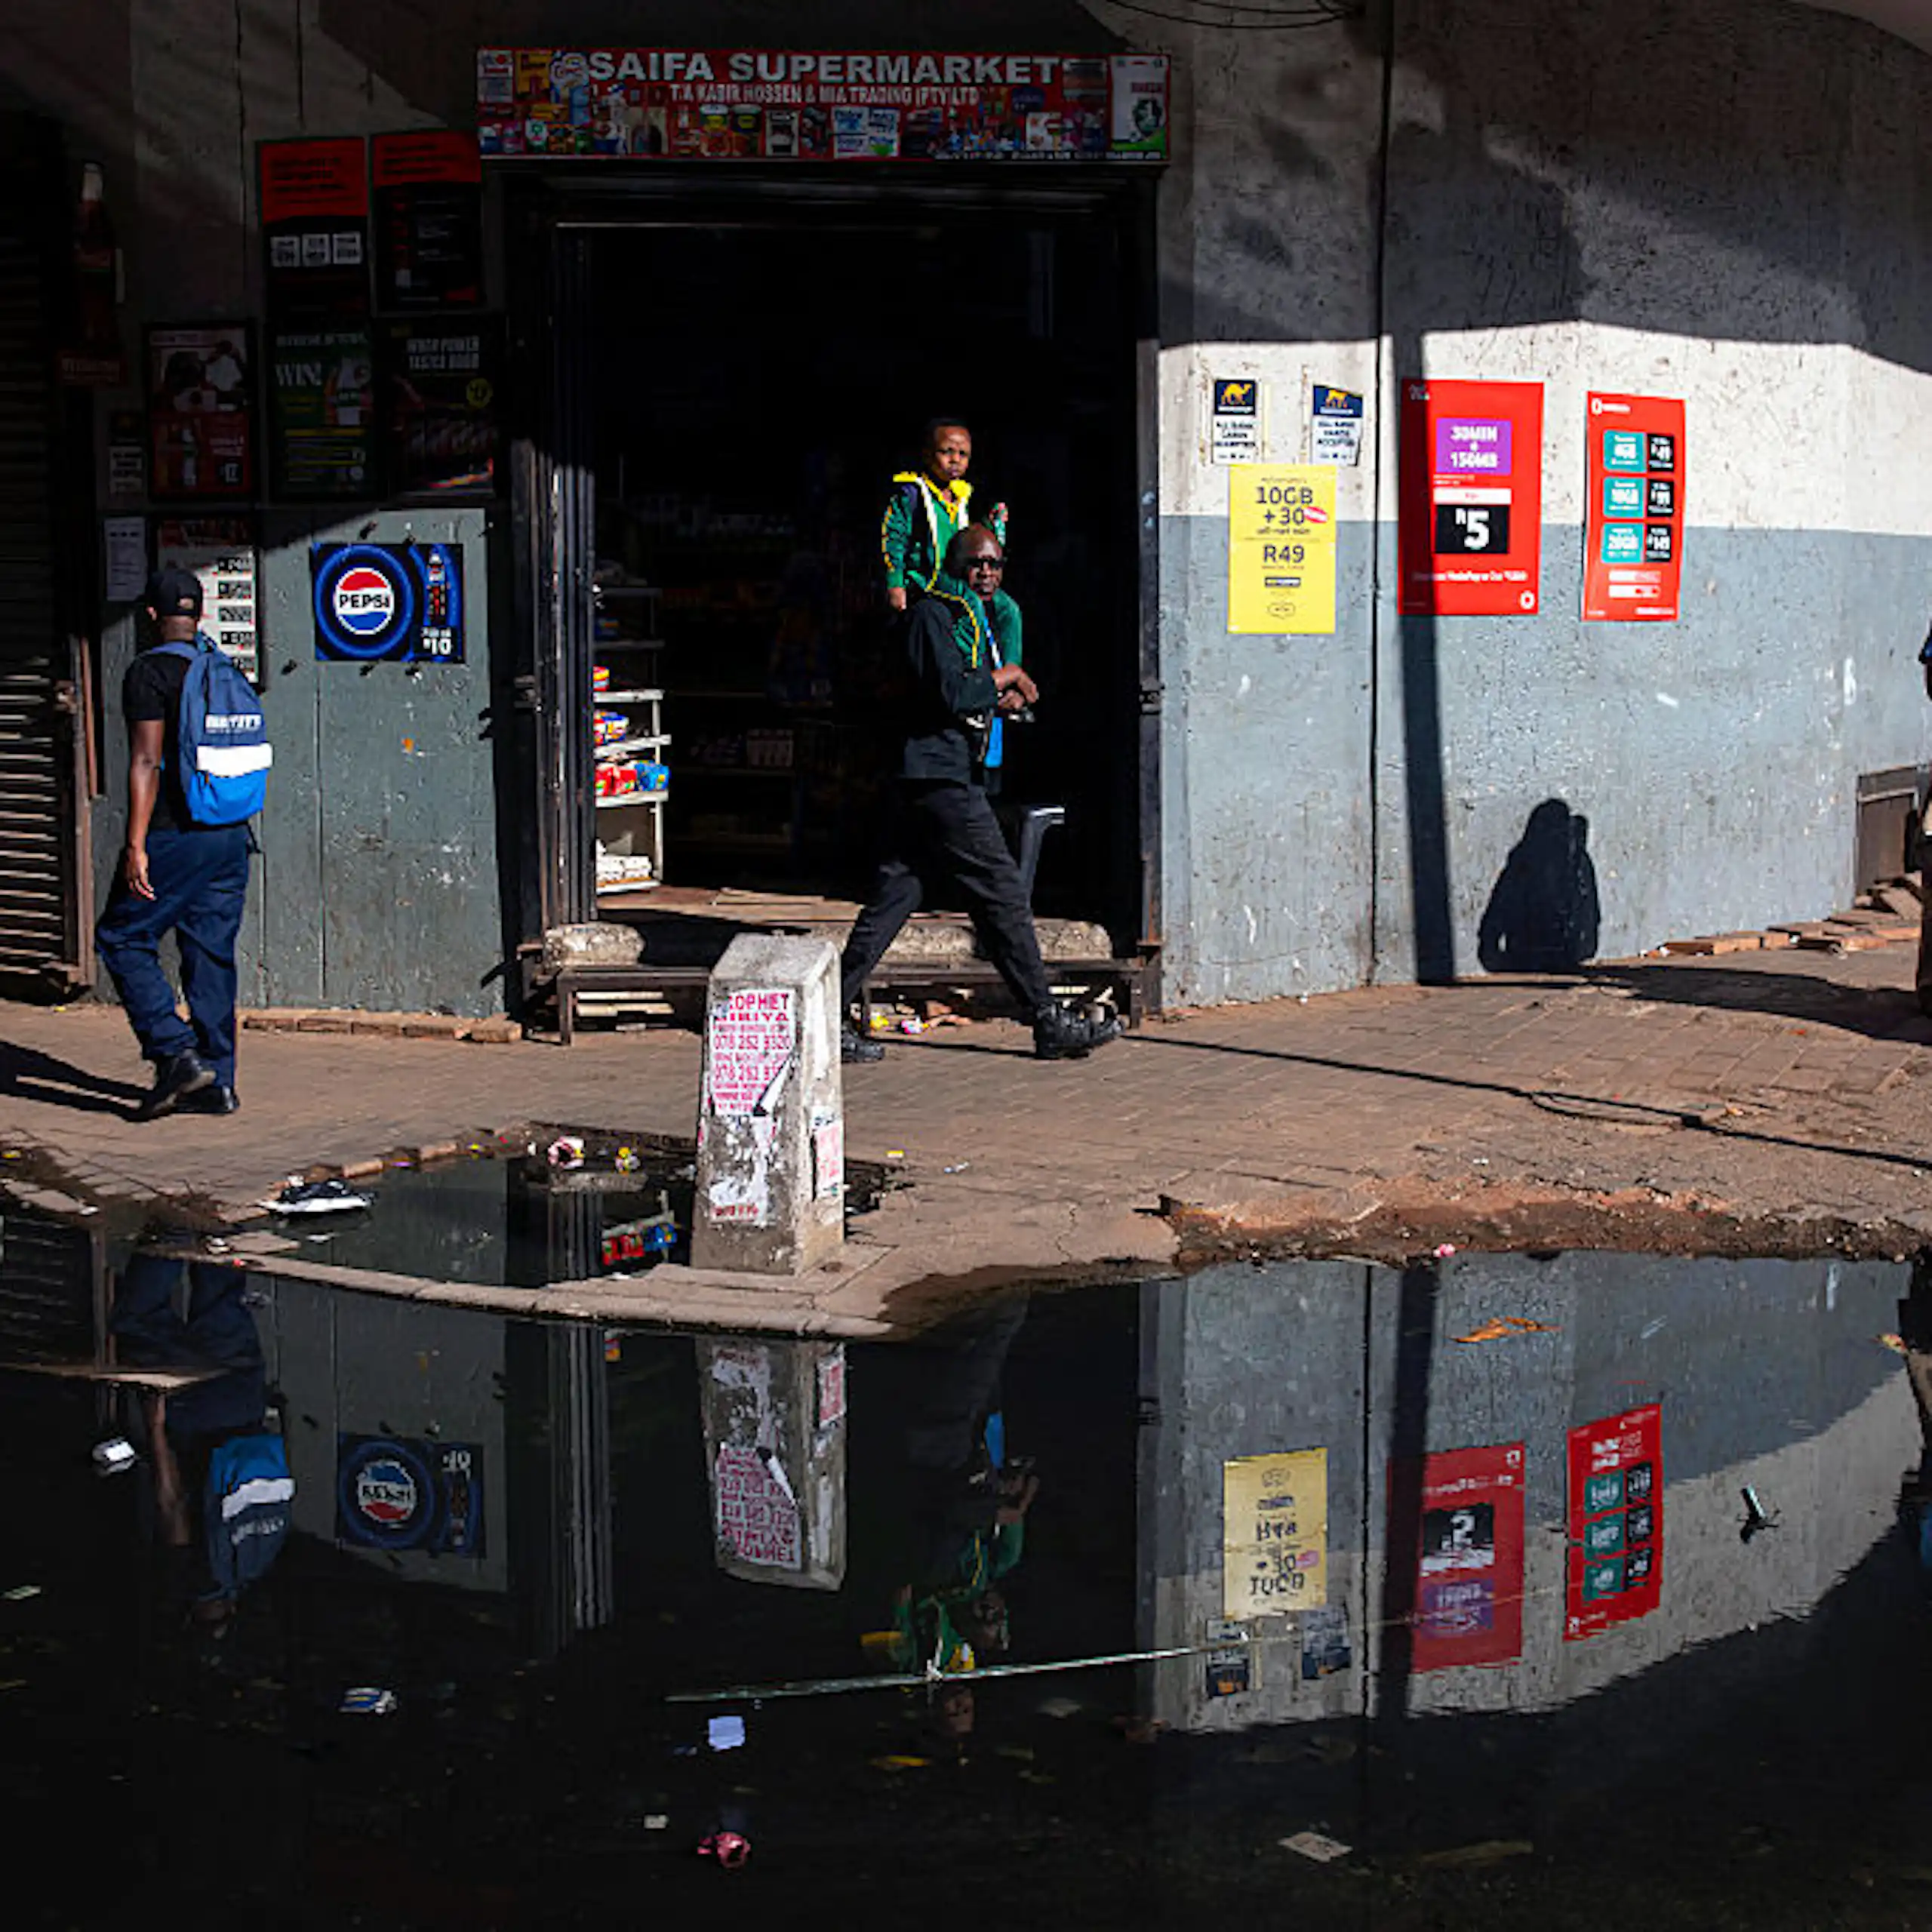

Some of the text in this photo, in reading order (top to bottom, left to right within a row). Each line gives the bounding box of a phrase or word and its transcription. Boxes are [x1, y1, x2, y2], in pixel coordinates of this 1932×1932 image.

[589, 52, 1060, 84] SAIFA SUPERMARKET
[848, 85, 912, 106] TRADING
[1254, 485, 1314, 505] 10GB
[1263, 545, 1305, 564] R49
[340, 593, 390, 608] PEPSI
